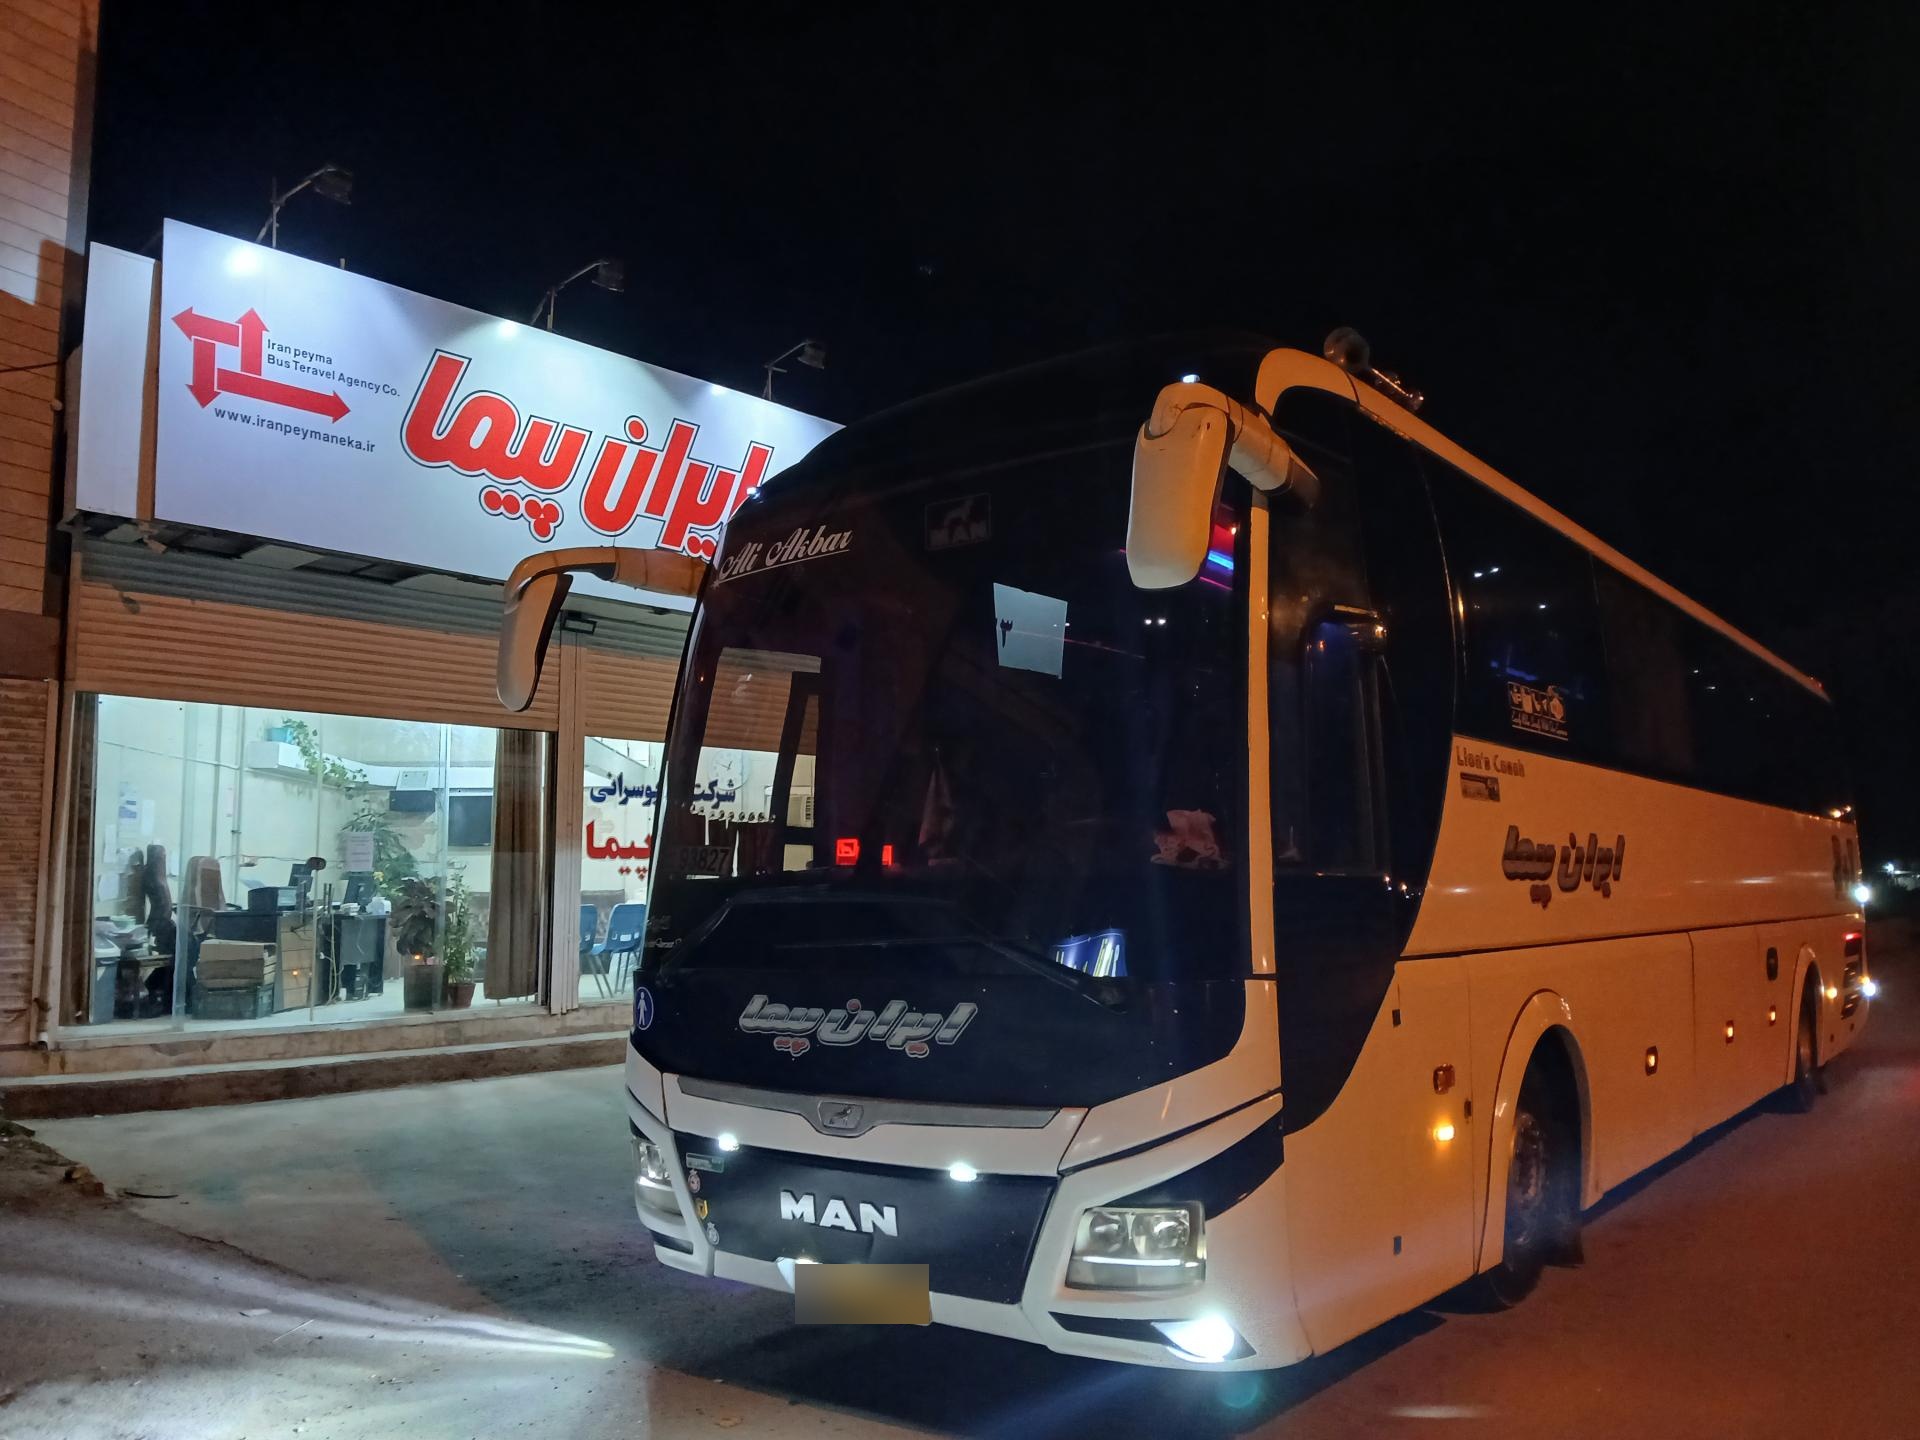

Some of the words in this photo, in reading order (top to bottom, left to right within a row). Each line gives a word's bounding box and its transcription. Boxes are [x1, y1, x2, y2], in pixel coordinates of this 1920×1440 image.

[266, 338, 292, 354] Iran
[294, 346, 333, 365] peyma
[267, 354, 291, 369] Bus
[292, 361, 336, 380] Teravel
[337, 372, 380, 394] Agency
[382, 383, 401, 397] Co.
[214, 407, 376, 453] www.iranpeymaneka.ir
[400, 348, 592, 542] پیما
[580, 415, 774, 559] ایران
[719, 542, 763, 580] Ali
[765, 524, 853, 567] Akbar
[1501, 824, 1557, 911] پیما
[1557, 831, 1626, 899] ایران
[738, 994, 826, 1057] پیما
[816, 998, 979, 1059] ایران
[779, 1190, 899, 1237] MAN
